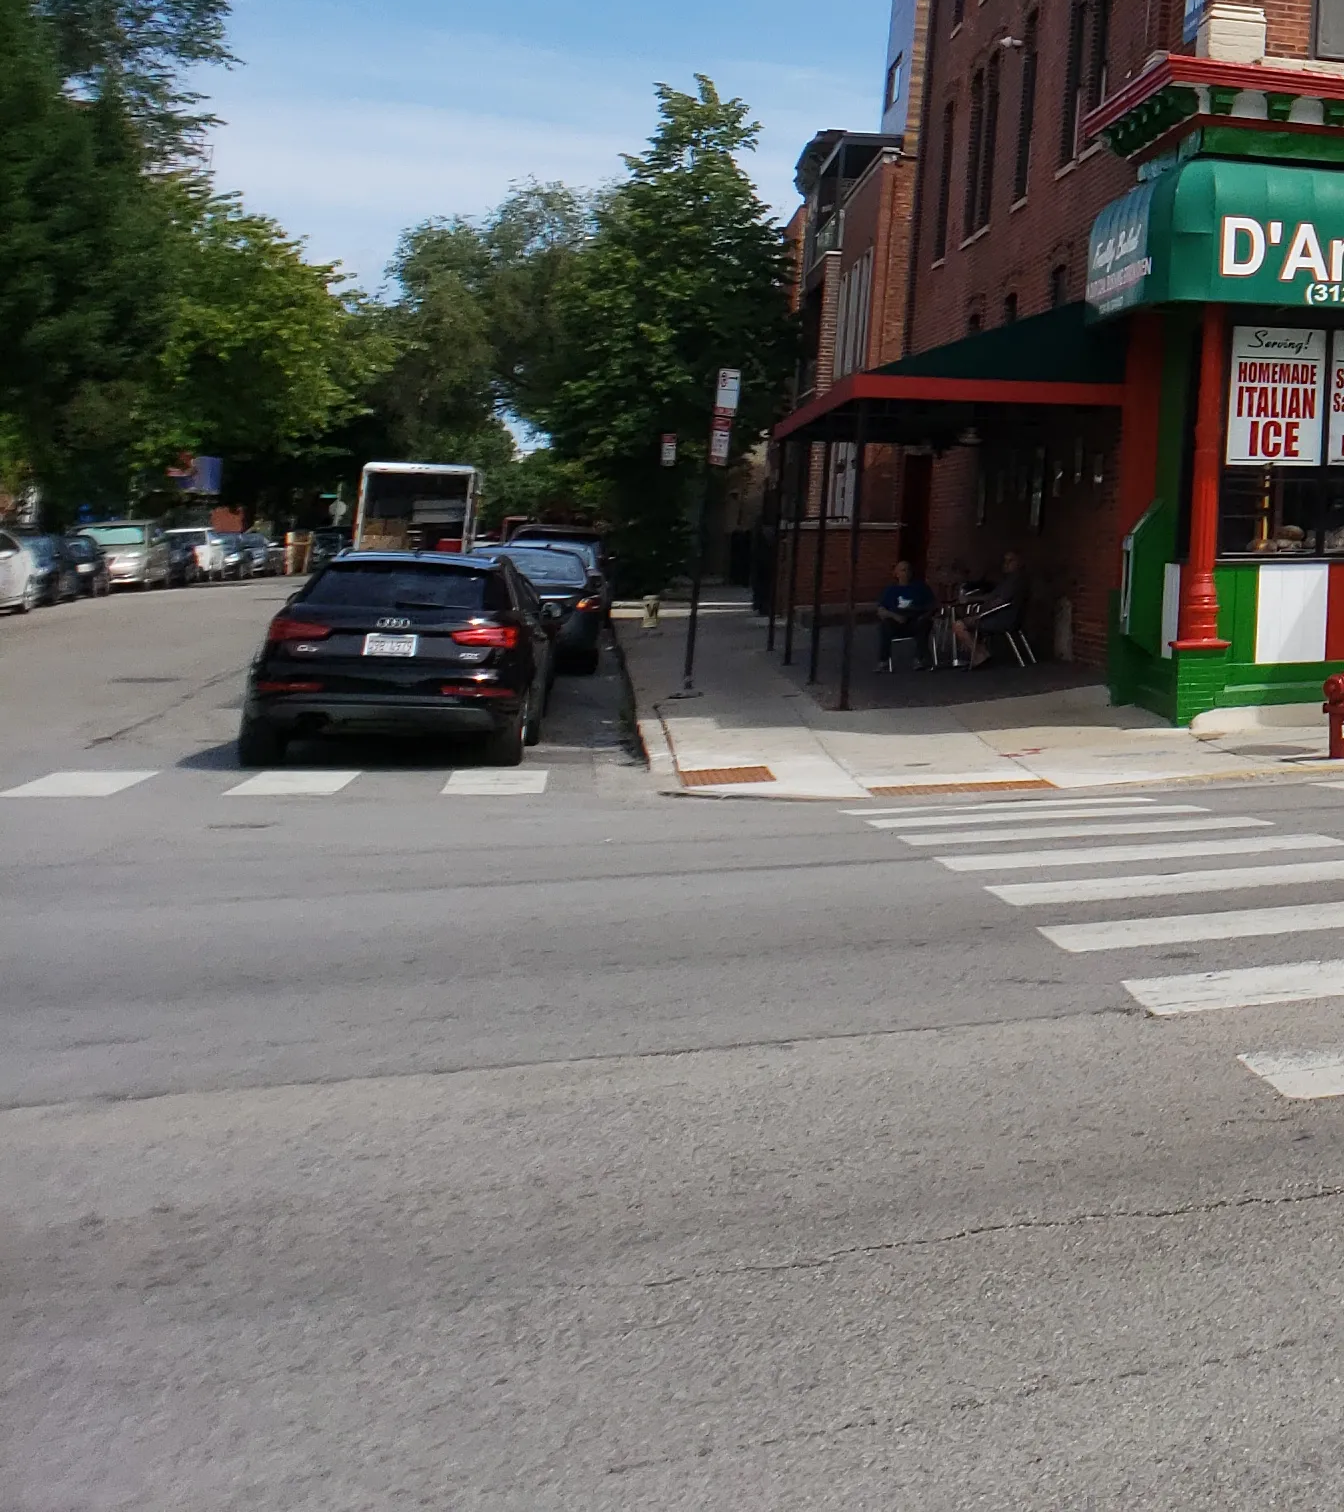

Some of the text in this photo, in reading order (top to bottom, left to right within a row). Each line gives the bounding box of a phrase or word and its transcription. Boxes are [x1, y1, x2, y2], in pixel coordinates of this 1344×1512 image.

[1248, 330, 1313, 354] Serving!
[1237, 362, 1317, 385] HOMEMADE
[1236, 386, 1316, 419] ITALIAN
[1248, 421, 1299, 457] ICE
